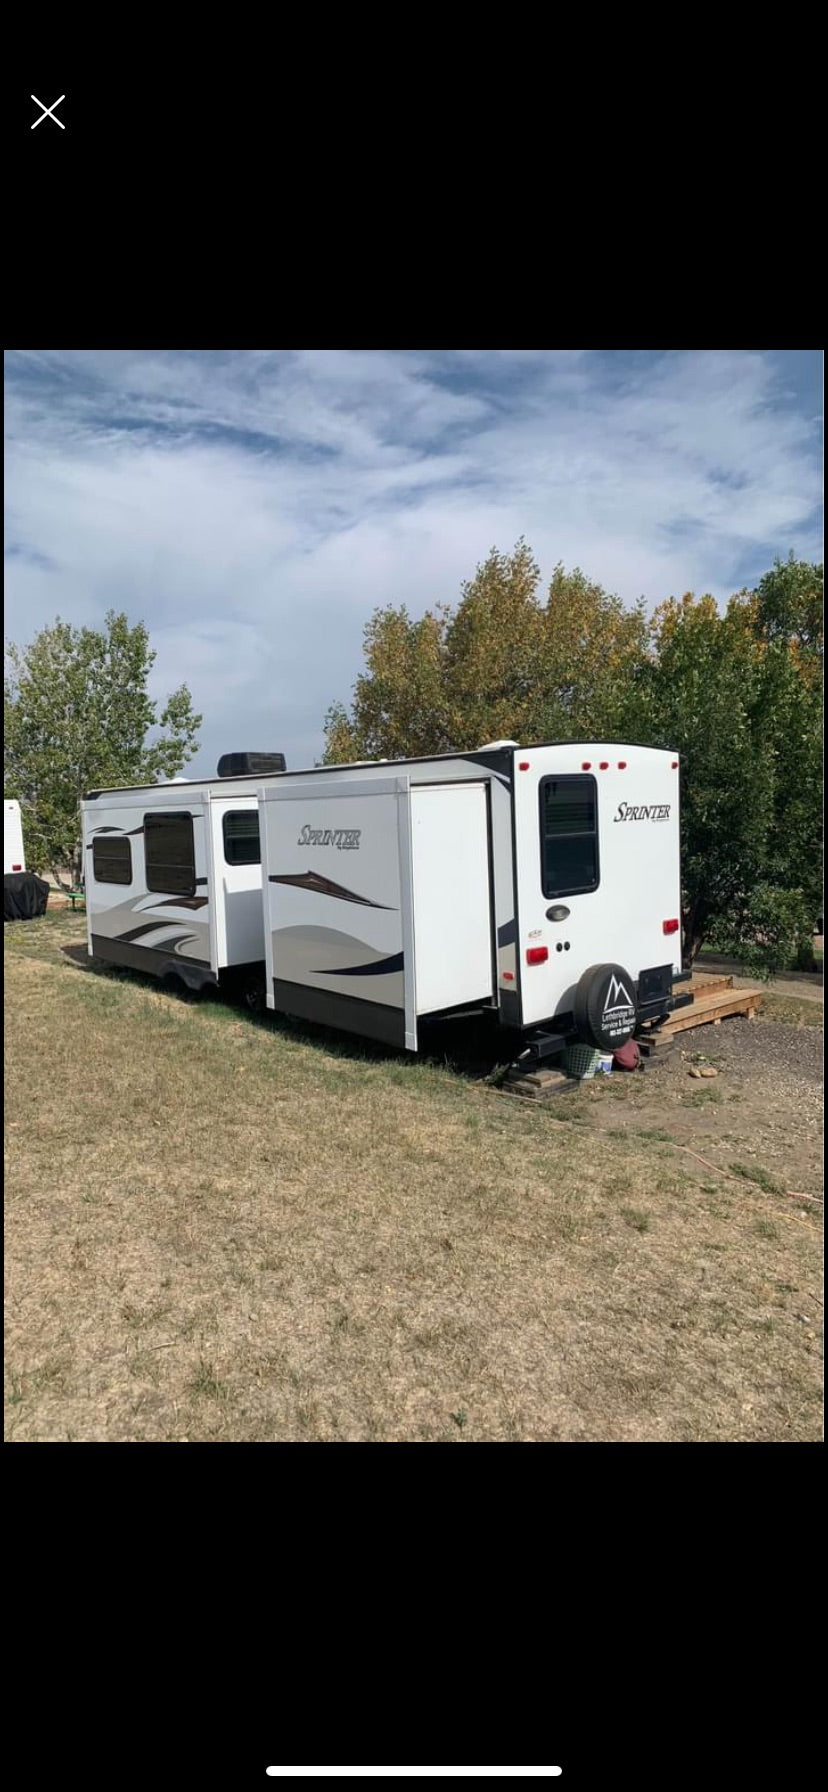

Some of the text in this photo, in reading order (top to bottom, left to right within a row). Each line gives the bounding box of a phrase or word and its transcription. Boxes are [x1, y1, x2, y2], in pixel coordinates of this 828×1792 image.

[613, 801, 671, 822] SPRINTER
[297, 824, 362, 847] SPRINTER
[601, 1022, 618, 1031] Service
